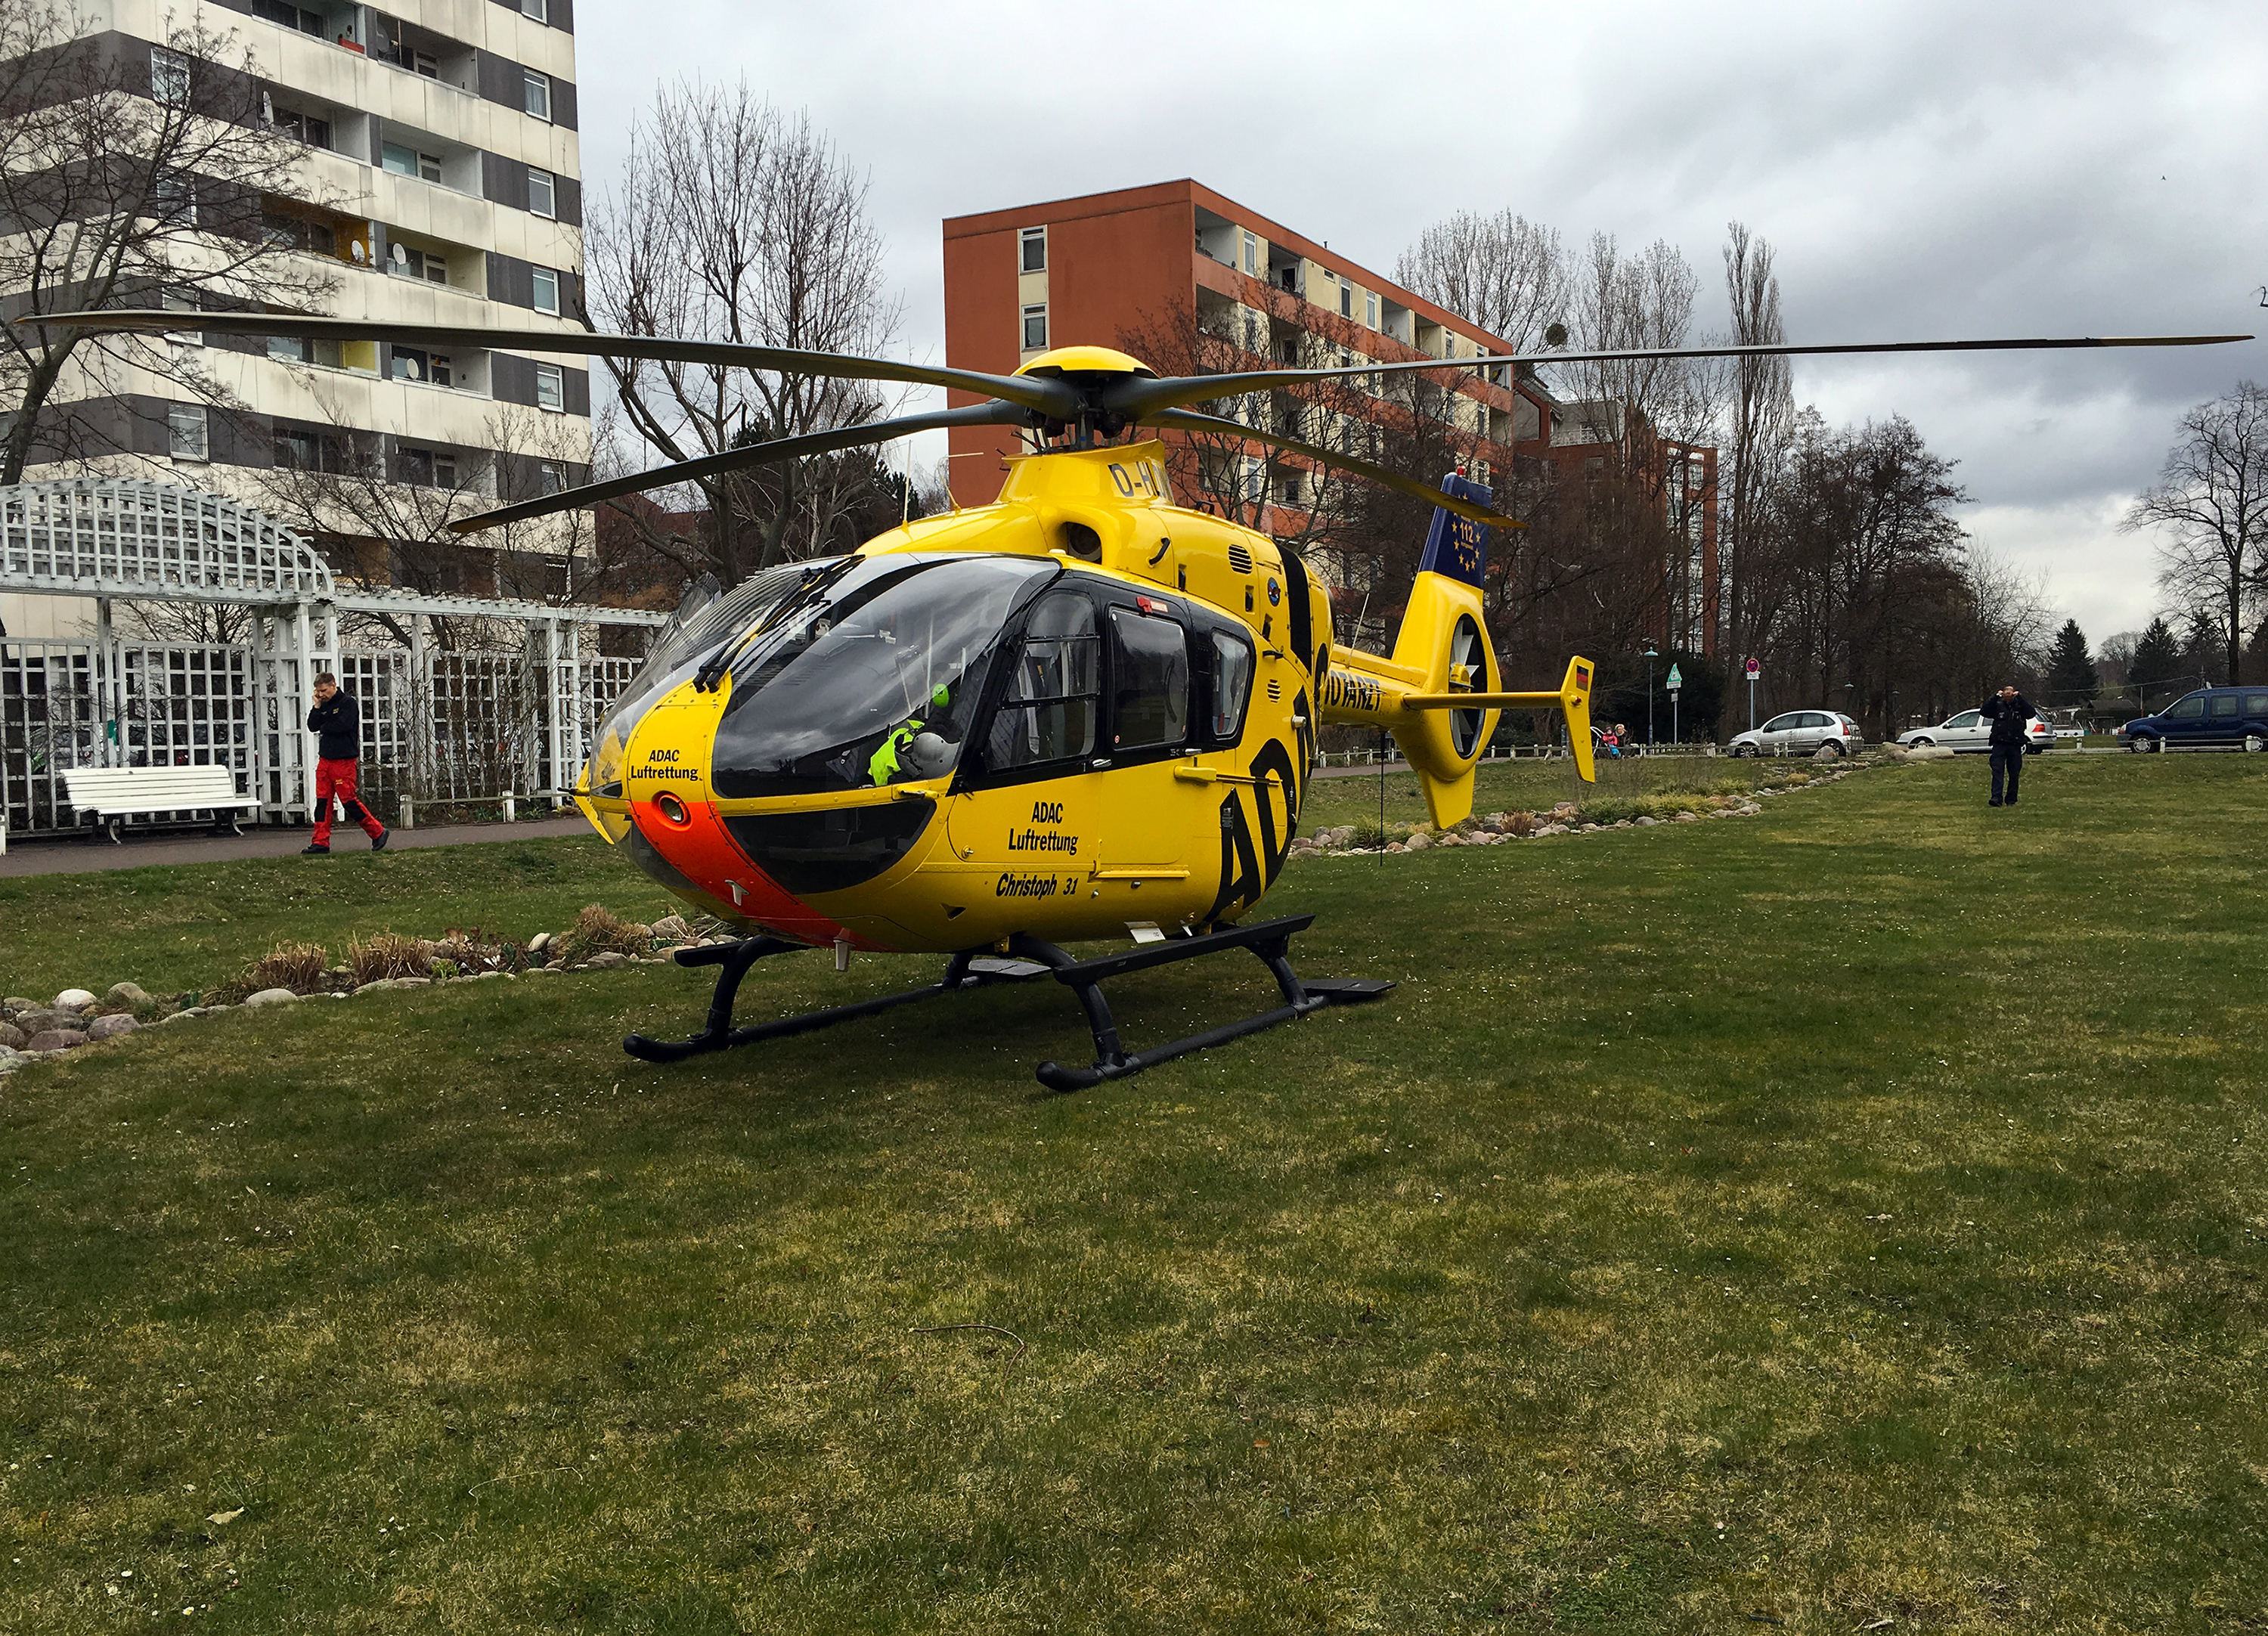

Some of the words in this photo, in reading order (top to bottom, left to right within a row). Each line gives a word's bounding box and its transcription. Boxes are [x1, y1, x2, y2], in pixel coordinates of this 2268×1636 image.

[1460, 522, 1473, 544] 112
[649, 749, 680, 762] ADAC
[631, 765, 699, 781] Luftrettung
[1031, 801, 1064, 824] ADAC
[1008, 828, 1079, 856] Luftrettung
[996, 872, 1058, 900] Christoph
[1062, 877, 1079, 895] 31
